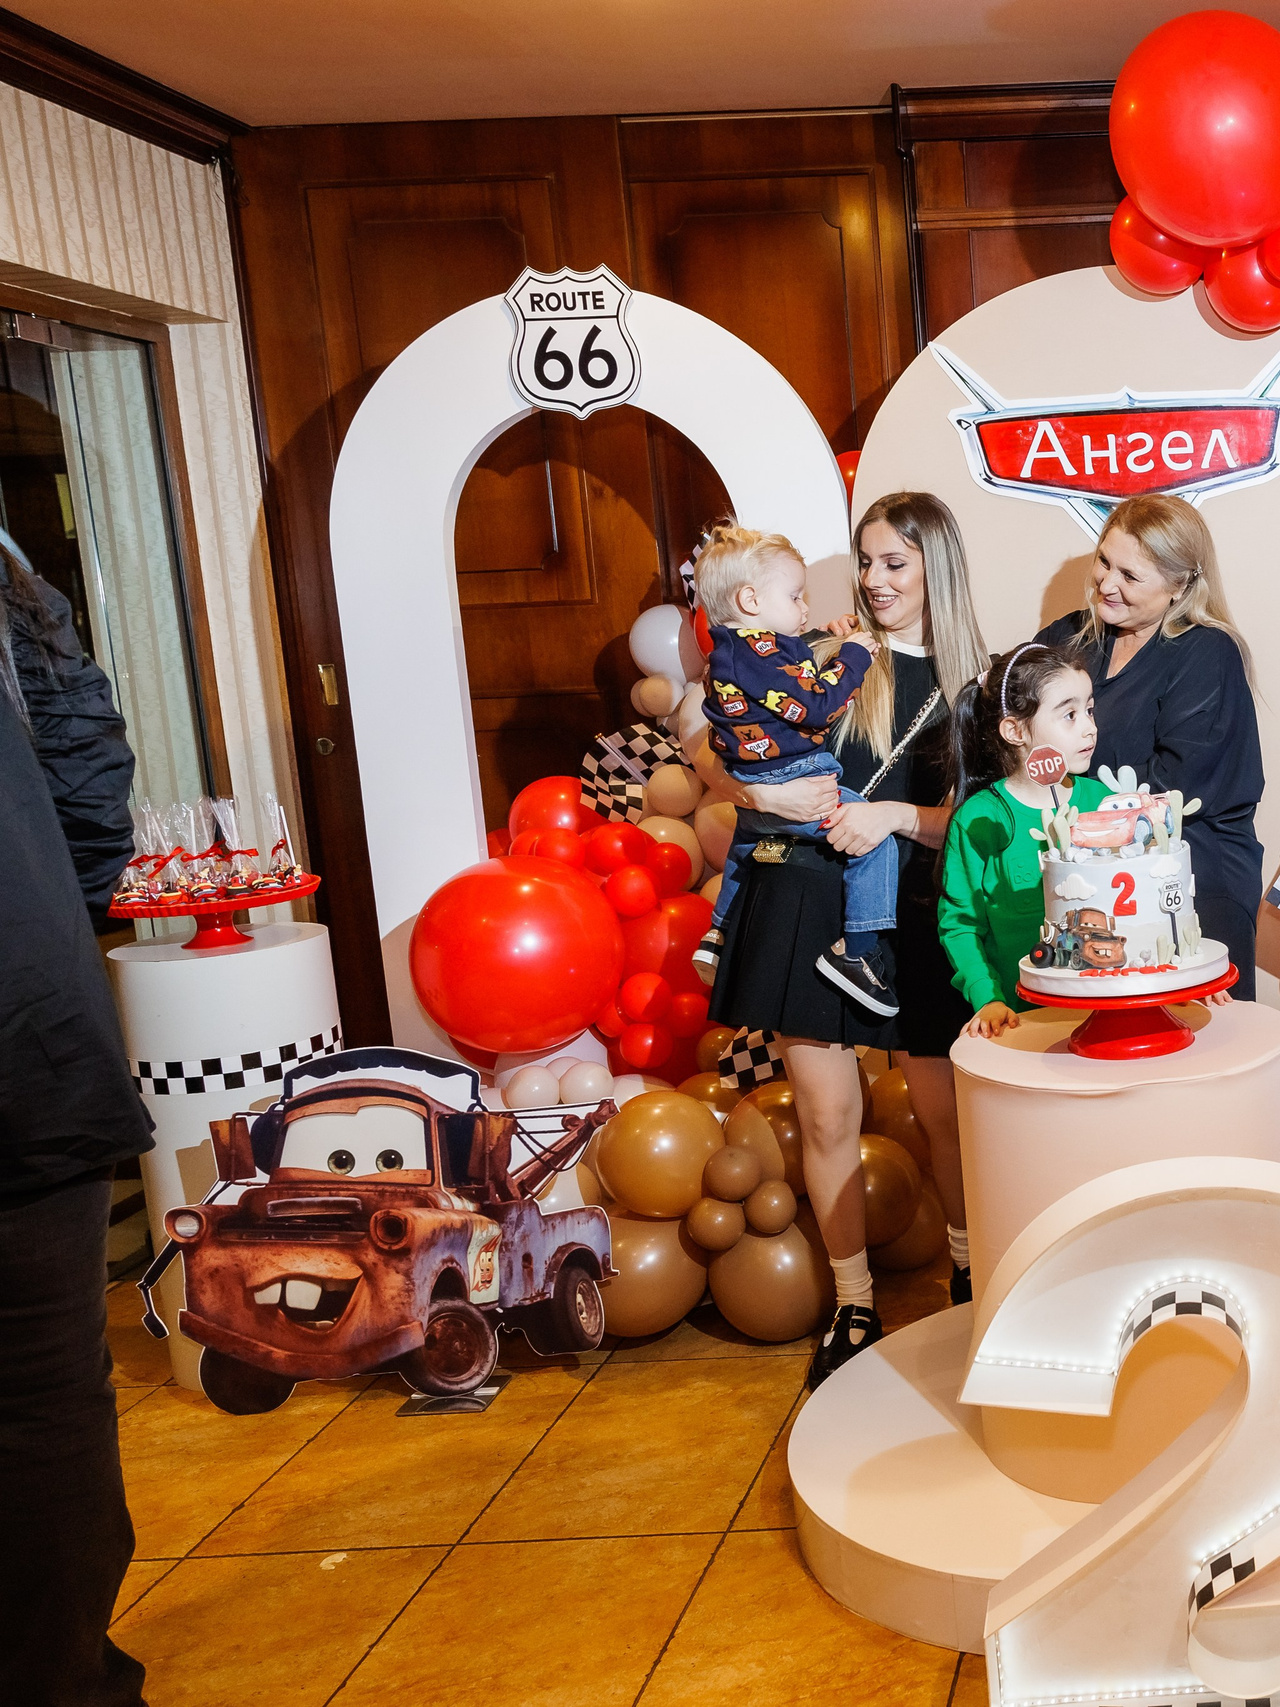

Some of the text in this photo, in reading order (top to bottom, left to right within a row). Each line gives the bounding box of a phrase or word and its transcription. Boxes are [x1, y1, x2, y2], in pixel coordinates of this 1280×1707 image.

[529, 290, 605, 312] ROUTE
[533, 324, 618, 391] 66
[1019, 420, 1239, 479] Ангел
[1028, 756, 1063, 777] STOP
[1111, 871, 1137, 917] 2
[1166, 890, 1182, 907] 66
